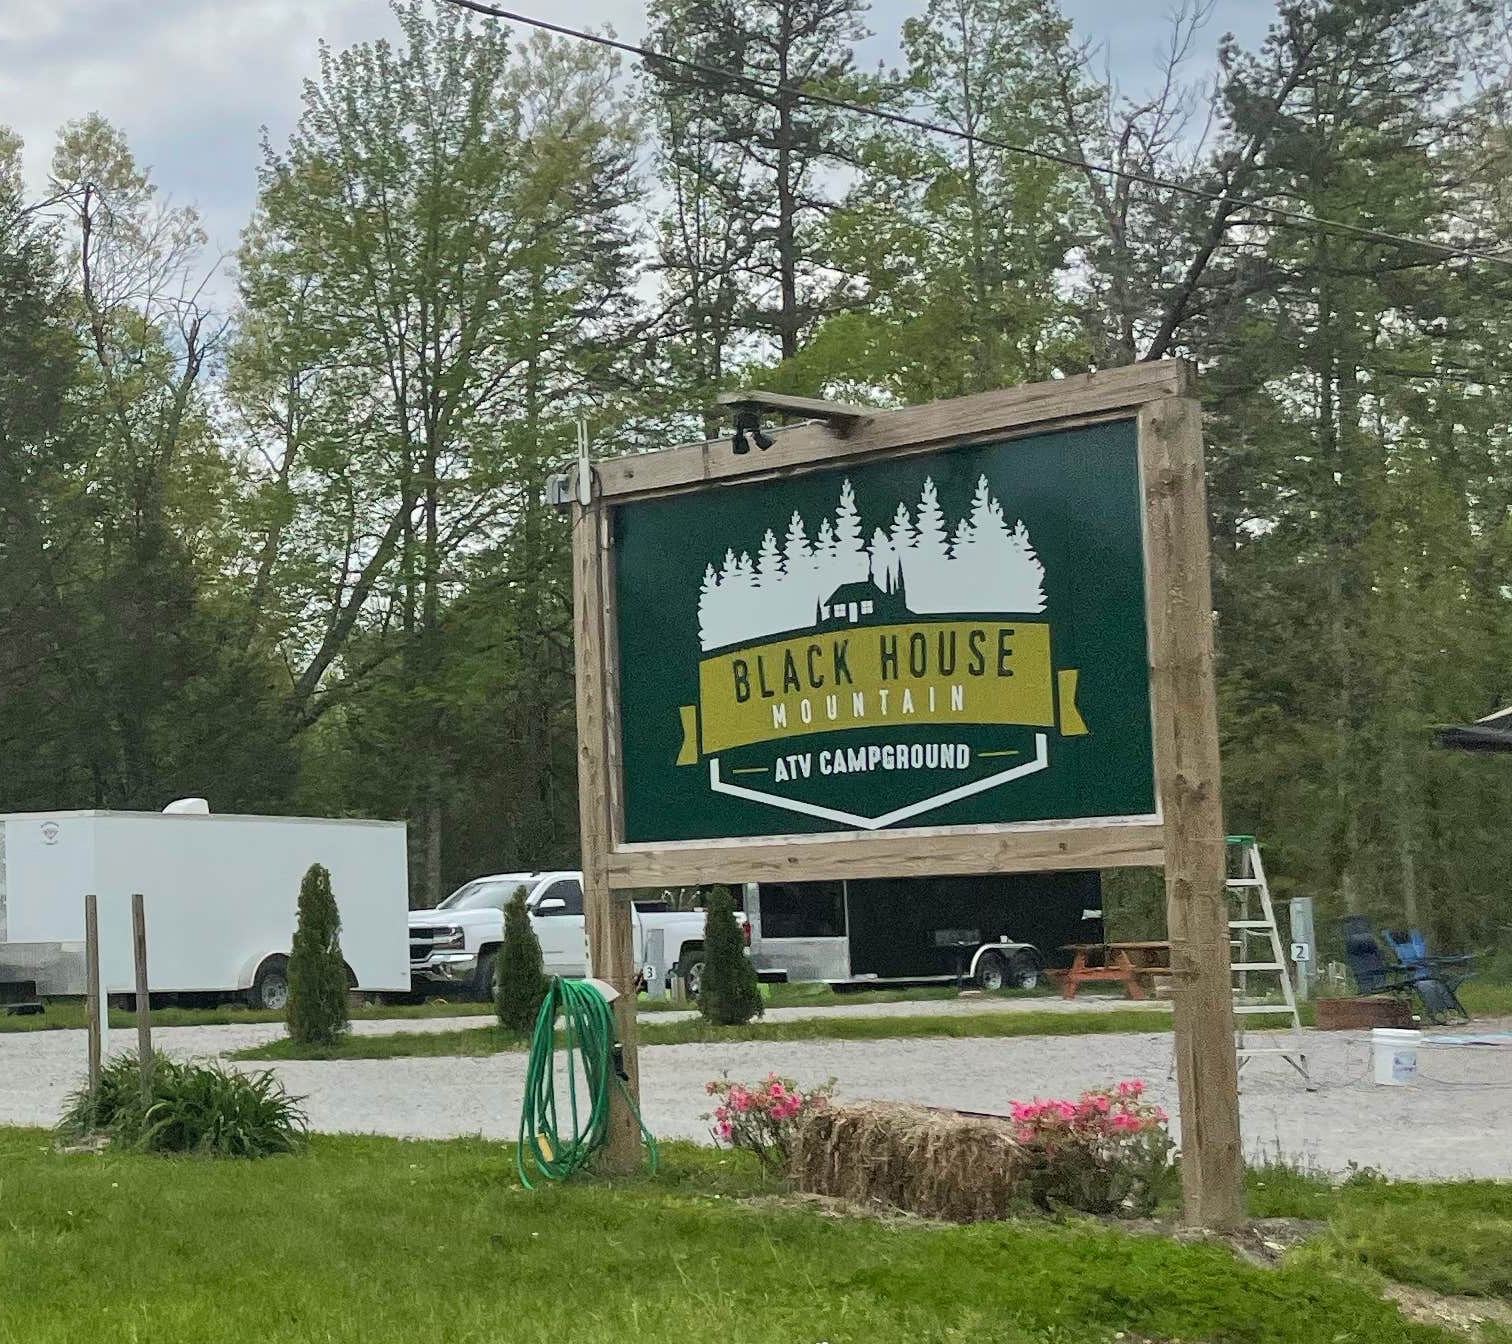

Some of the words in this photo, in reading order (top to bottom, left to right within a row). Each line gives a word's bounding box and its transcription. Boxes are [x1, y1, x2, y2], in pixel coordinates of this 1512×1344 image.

[732, 639, 853, 703] BLACK
[879, 629, 1015, 681] HOUSE
[771, 684, 964, 729] MOUNTAIN
[774, 753, 812, 782] ATV
[819, 743, 971, 775] CAMPGROUND
[1295, 945, 1305, 959] 2
[646, 966, 653, 978] 3
